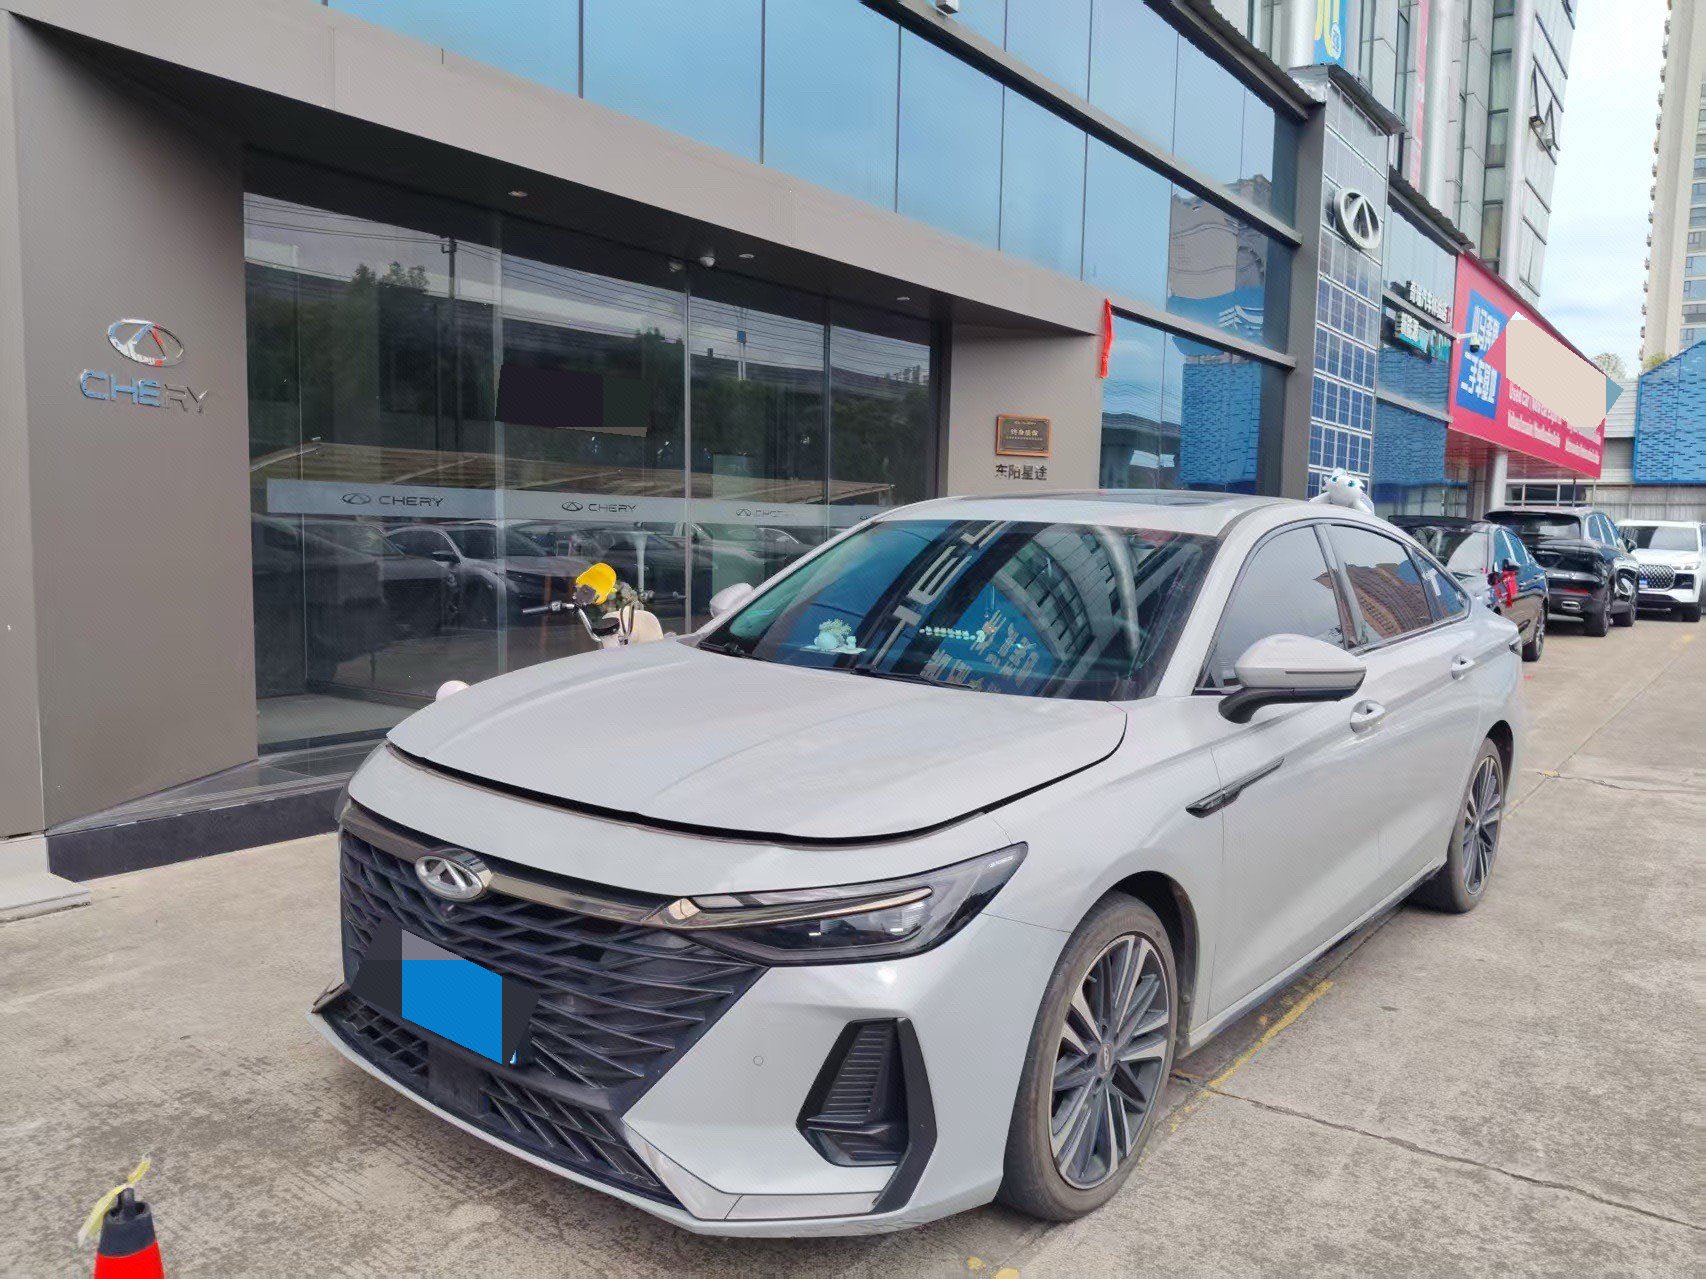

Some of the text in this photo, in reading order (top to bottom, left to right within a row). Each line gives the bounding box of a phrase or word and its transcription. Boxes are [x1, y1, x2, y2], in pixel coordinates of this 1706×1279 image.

[79, 369, 208, 413] CHERY
[994, 463, 1048, 480] 东阳星途
[378, 495, 444, 507] CHERY
[587, 503, 637, 513] CHERY
